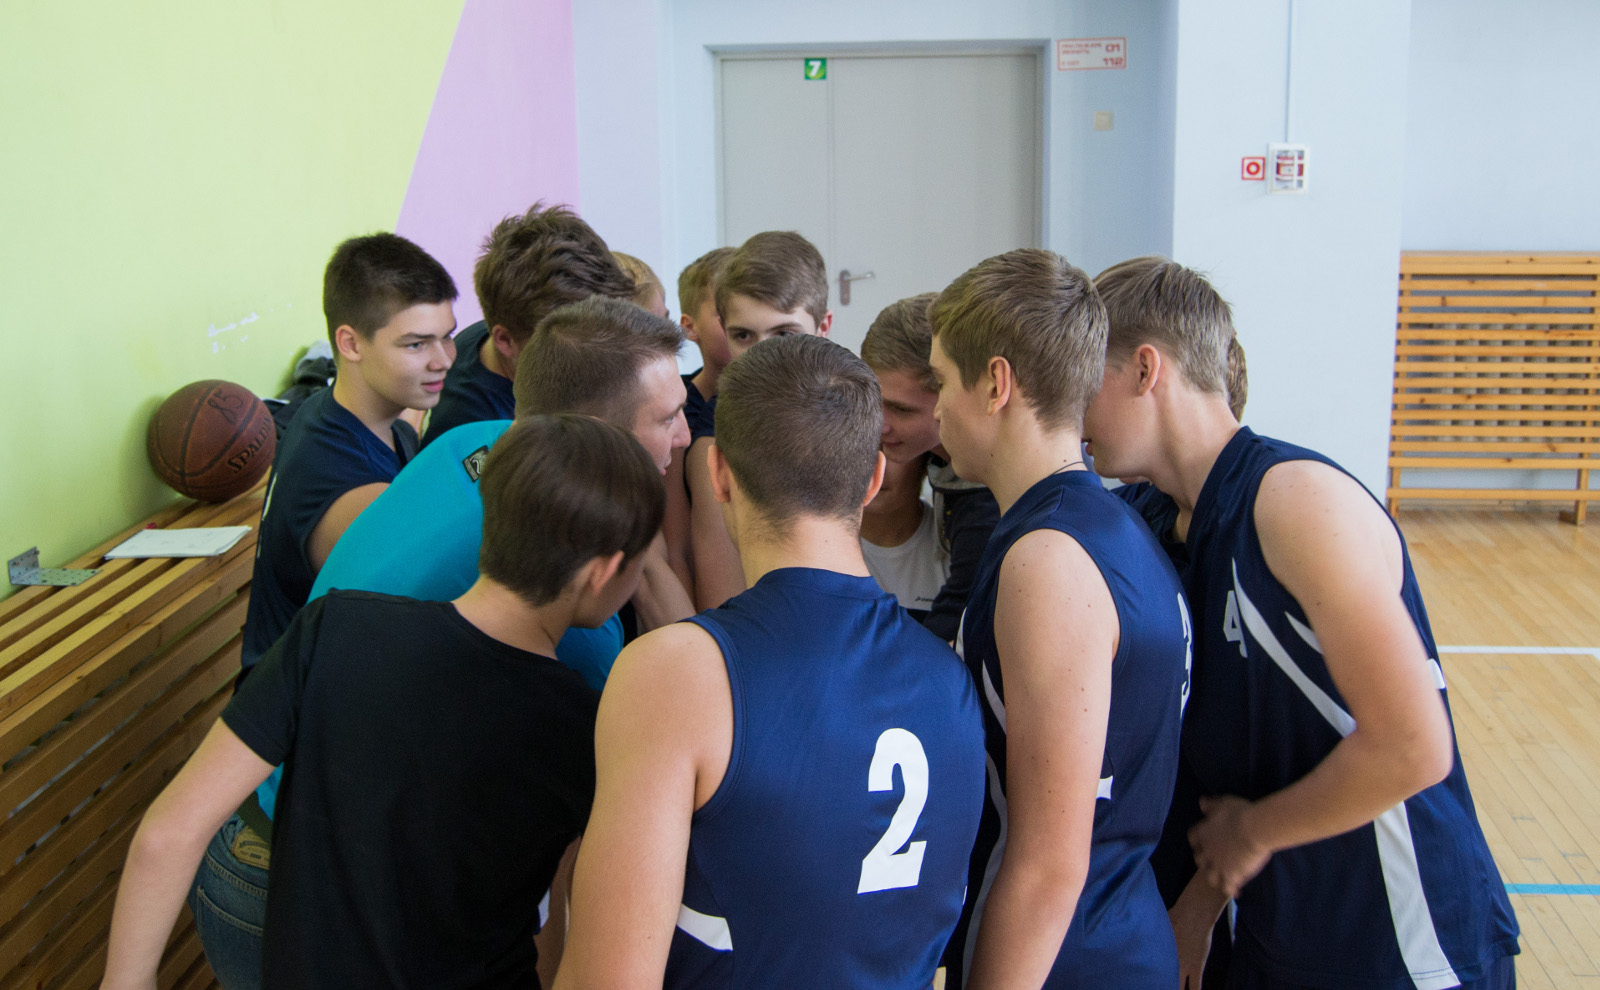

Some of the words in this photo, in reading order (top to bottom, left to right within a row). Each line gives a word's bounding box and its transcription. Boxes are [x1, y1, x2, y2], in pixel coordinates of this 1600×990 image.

[1105, 43, 1120, 53] 01
[808, 61, 821, 76] 7
[1104, 57, 1123, 66] 112
[1223, 590, 1248, 658] 4
[857, 728, 929, 894] 2
